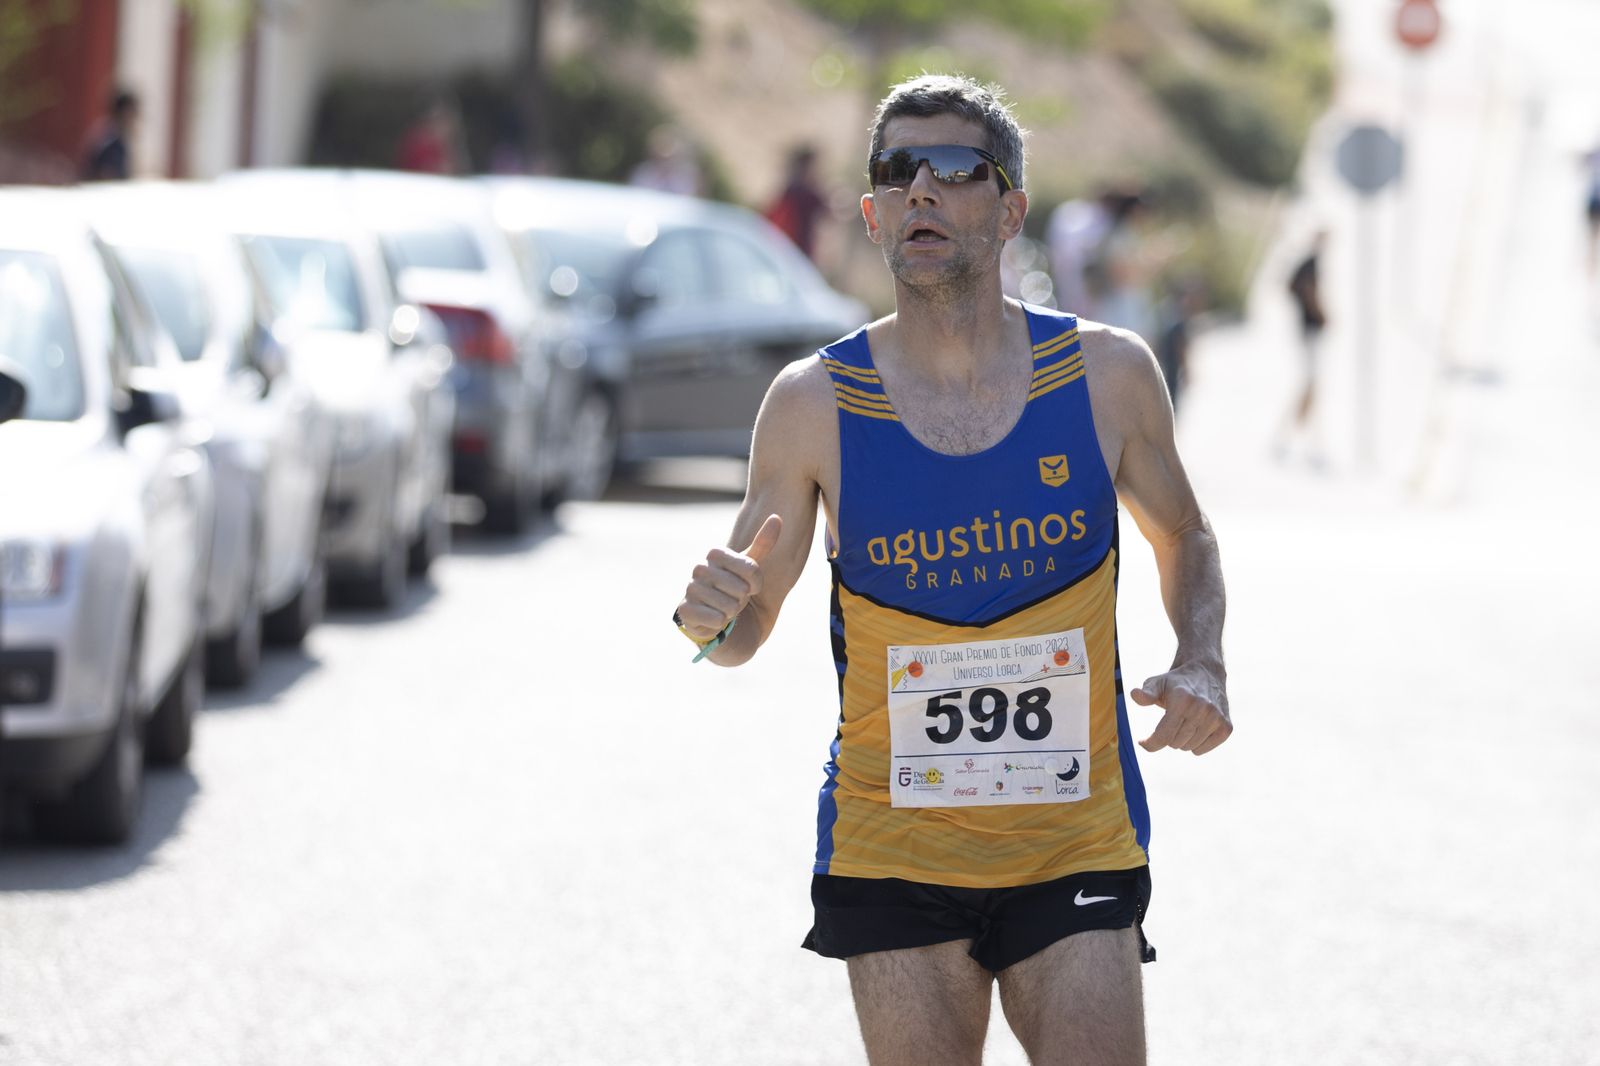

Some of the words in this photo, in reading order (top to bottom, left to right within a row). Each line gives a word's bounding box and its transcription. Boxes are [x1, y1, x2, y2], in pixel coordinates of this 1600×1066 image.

[867, 509, 1087, 574] agustinos
[906, 557, 1056, 590] GRANADA
[1045, 637, 1069, 654] 2023
[925, 687, 1052, 744] 598
